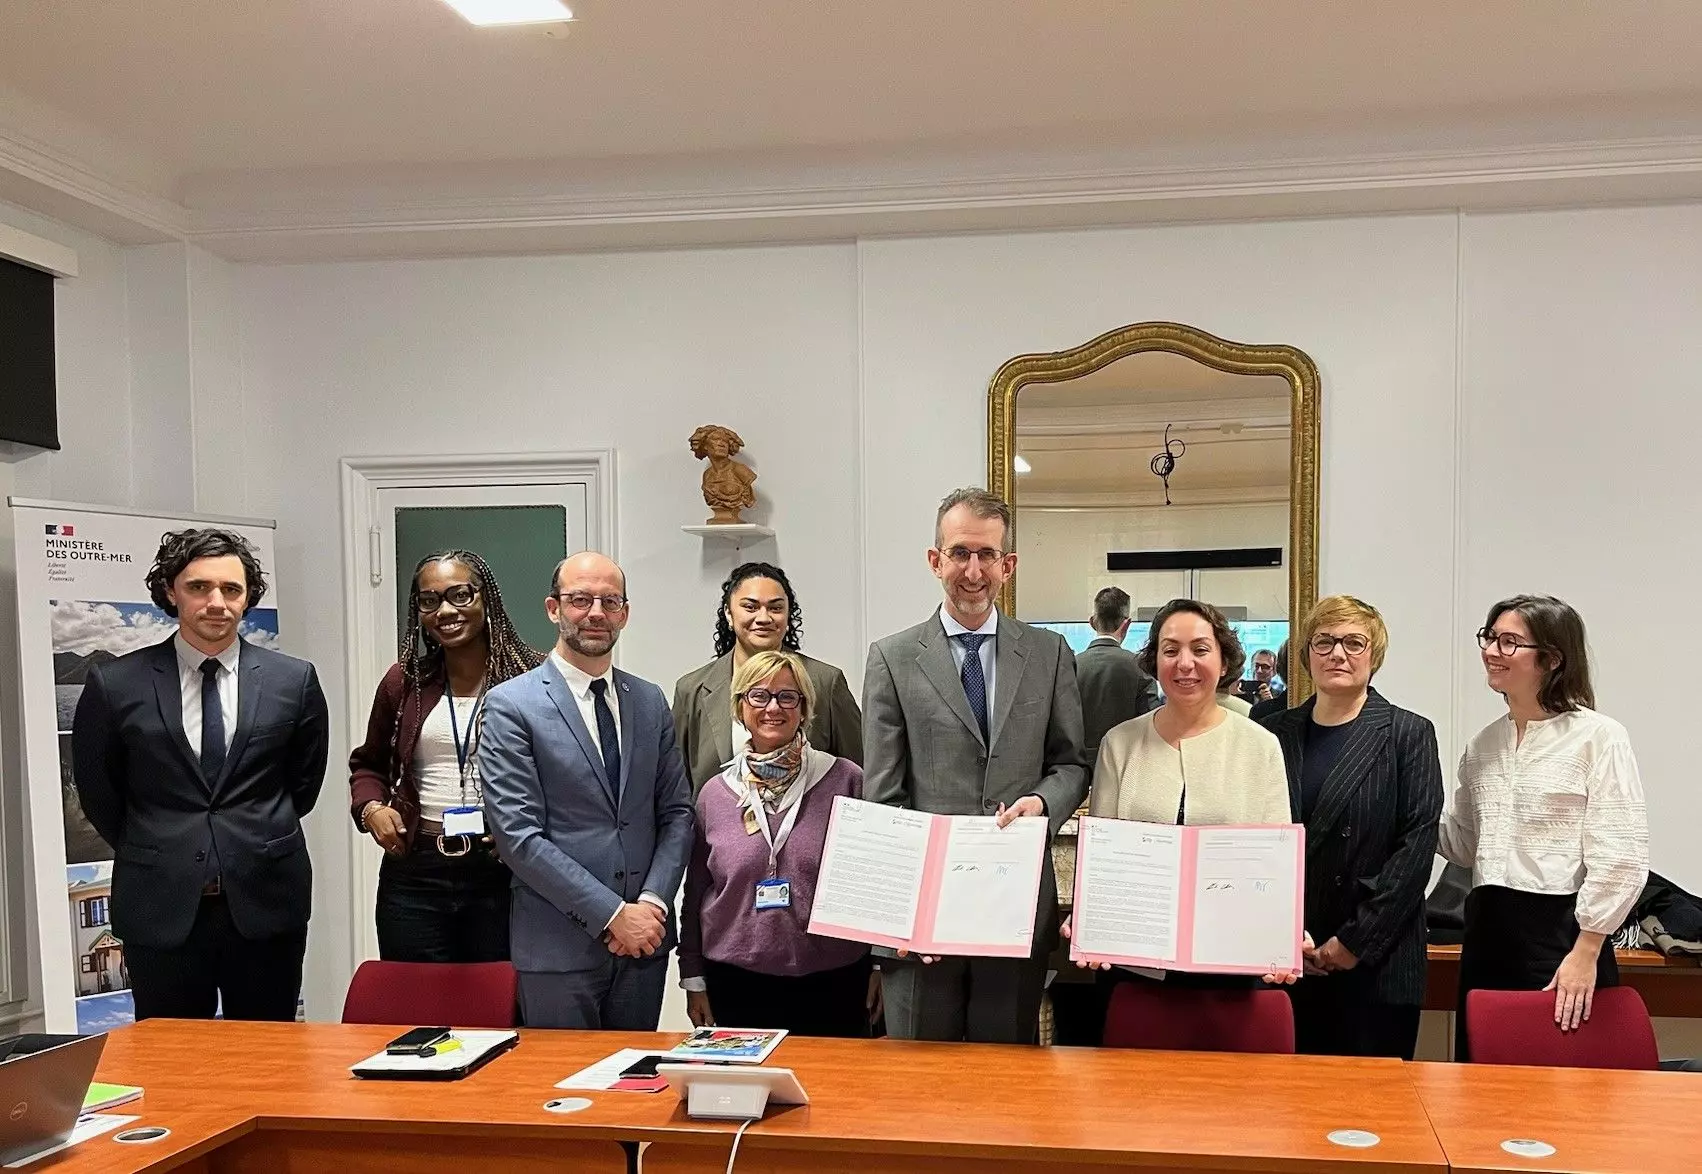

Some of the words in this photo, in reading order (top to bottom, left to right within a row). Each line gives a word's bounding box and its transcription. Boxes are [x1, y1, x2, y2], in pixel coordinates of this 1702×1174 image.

[46, 539, 104, 551] MINISTÈRE
[46, 549, 67, 559] DES
[70, 551, 132, 563] OUTRE-MER
